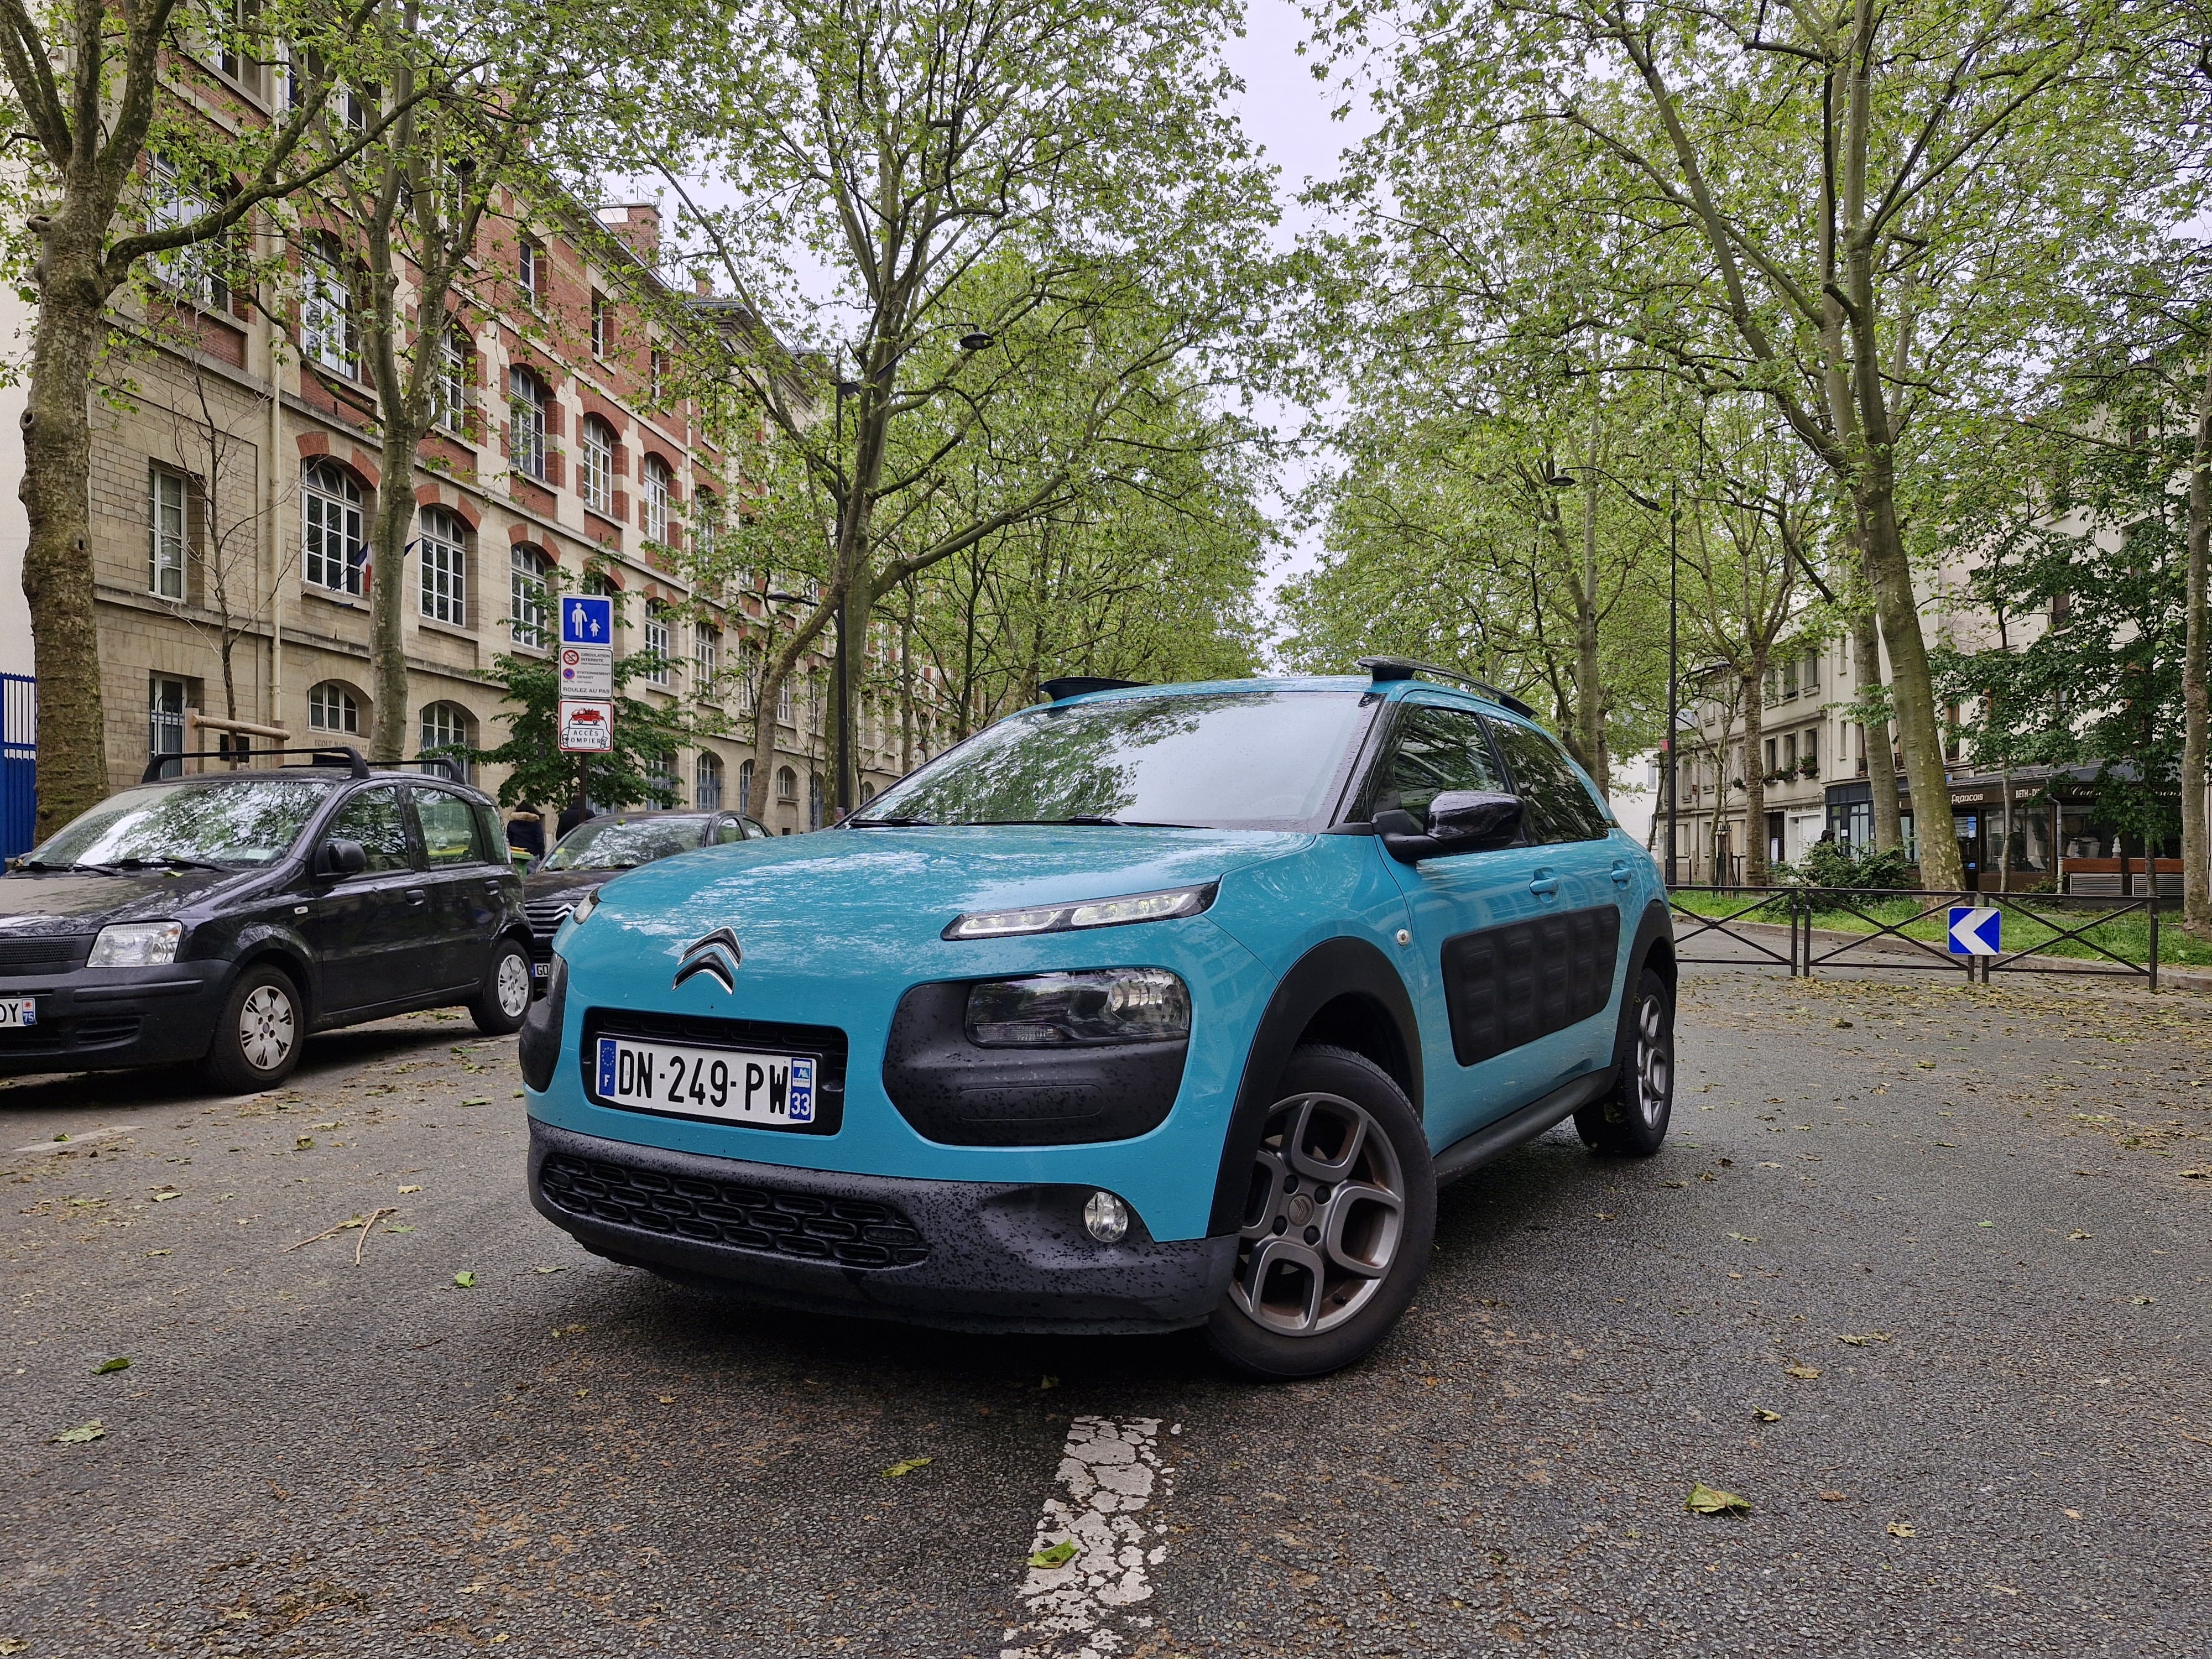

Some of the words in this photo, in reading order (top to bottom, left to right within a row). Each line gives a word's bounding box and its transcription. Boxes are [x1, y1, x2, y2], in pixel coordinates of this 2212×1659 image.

[536, 965, 549, 975] GD
[23, 1013, 34, 1022] 75
[604, 1074, 611, 1087] F
[618, 1049, 789, 1114] DN-249-PW
[791, 1092, 810, 1115] 33
